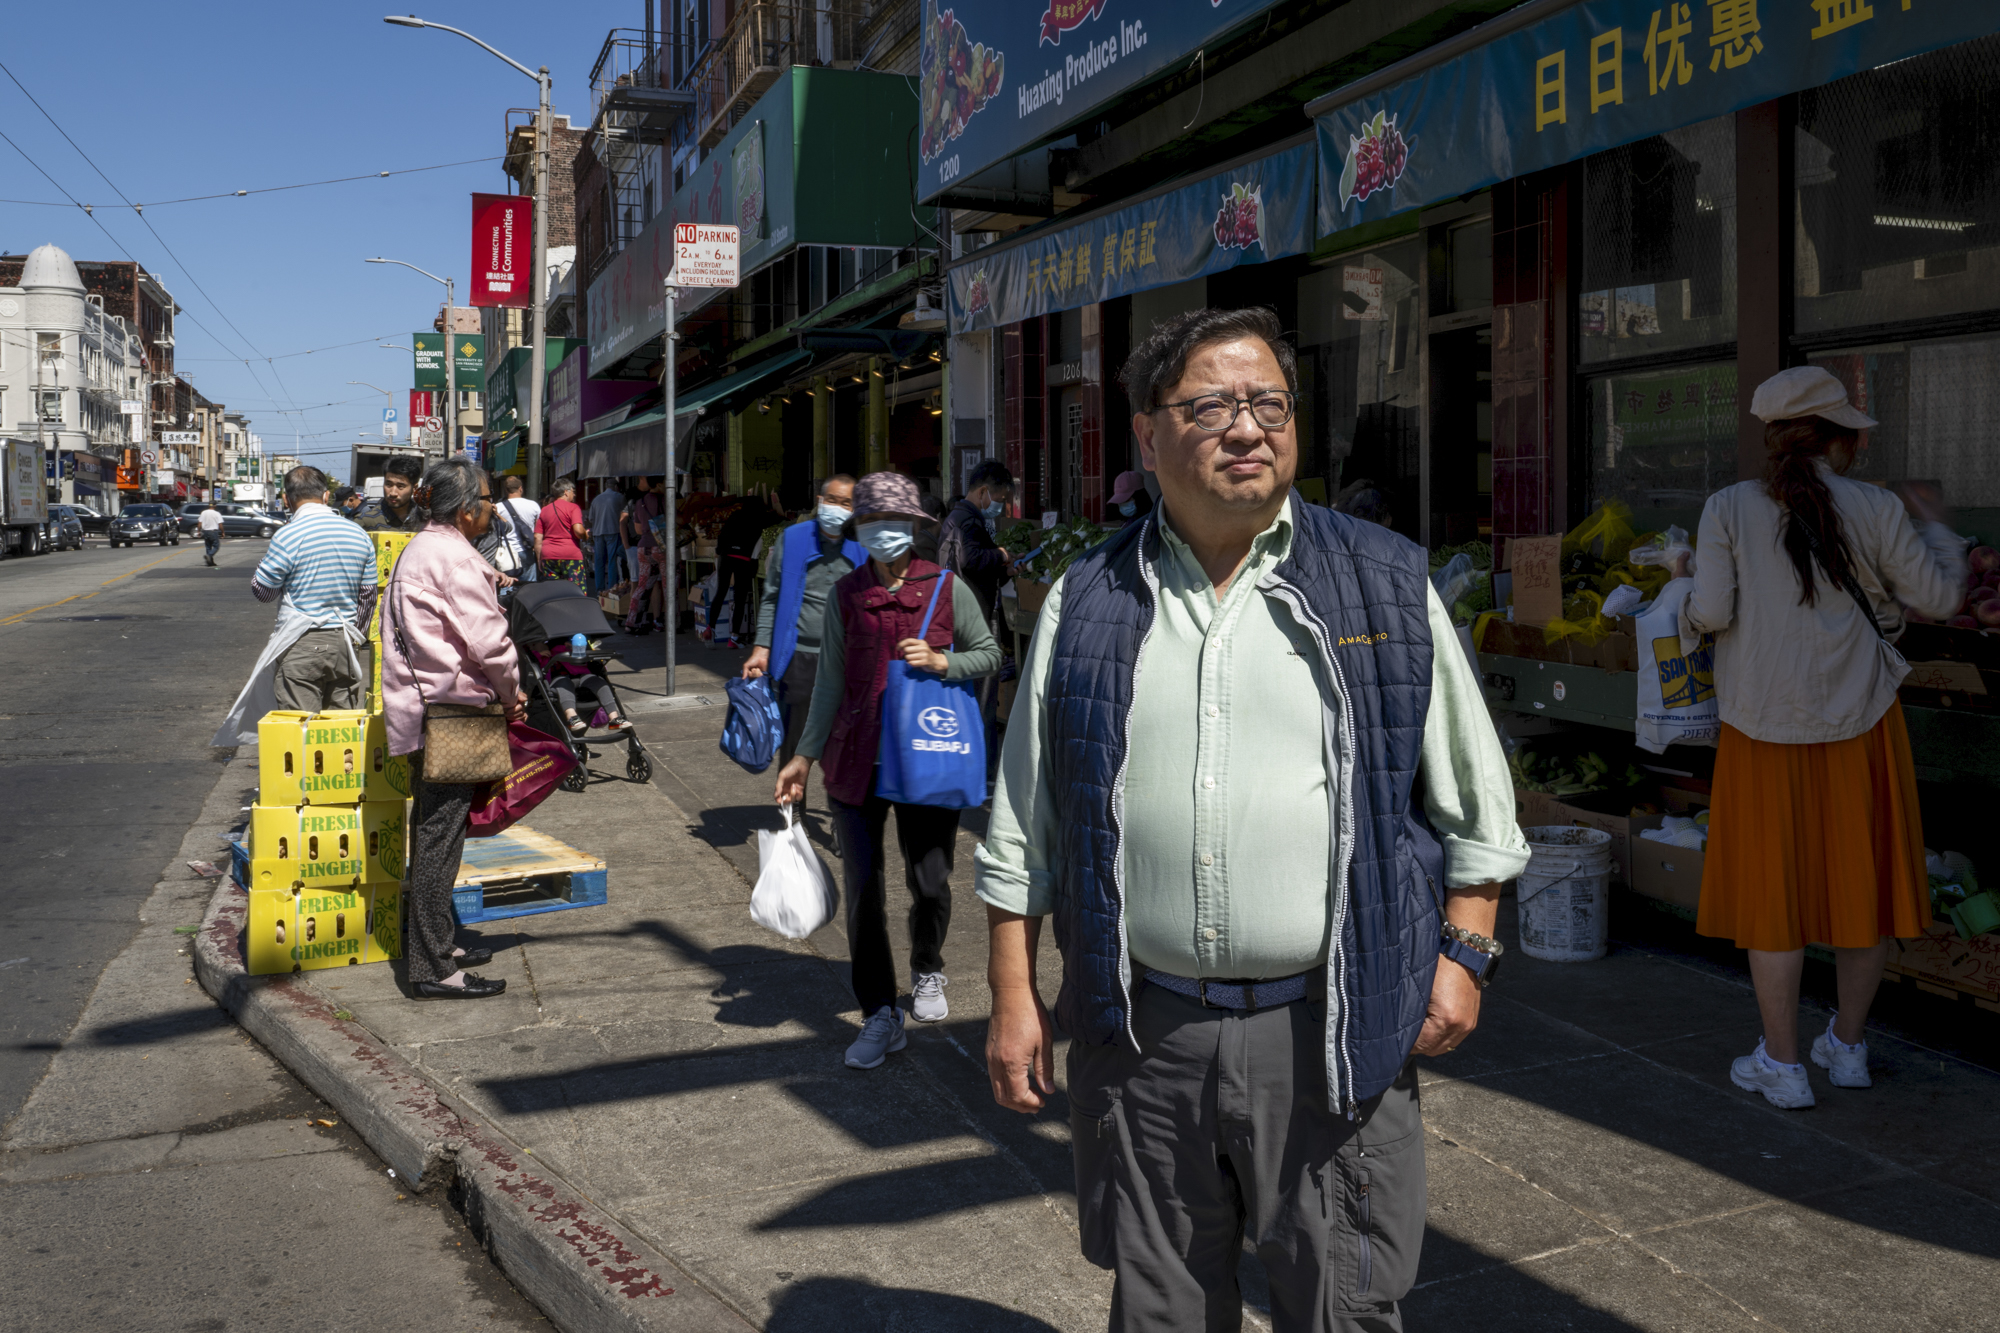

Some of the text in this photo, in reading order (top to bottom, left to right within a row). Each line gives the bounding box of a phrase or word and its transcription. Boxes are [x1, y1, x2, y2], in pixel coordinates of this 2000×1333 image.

[1018, 20, 1147, 119] Huaxing Produce Inc.
[939, 154, 960, 184] 1200
[502, 208, 513, 272] Communities
[678, 226, 695, 243] NO
[698, 230, 737, 246] PARKING
[492, 226, 500, 271] CONNECTING
[682, 276, 734, 285] STREET CLEANING
[1027, 243, 1091, 298] 天天新鮮
[590, 325, 634, 363] Fruit Garden
[1660, 657, 1687, 684] SAN
[1643, 713, 1711, 723] SOUVENIRS GIFTS
[305, 726, 365, 745] FRESH
[1683, 728, 1712, 739] PIER
[299, 773, 368, 792] GINGER
[300, 814, 361, 832] FRESH
[300, 859, 363, 878] GINGER
[299, 893, 357, 914] FRESH
[455, 895, 477, 904] 4840
[290, 938, 359, 961] GINGER
